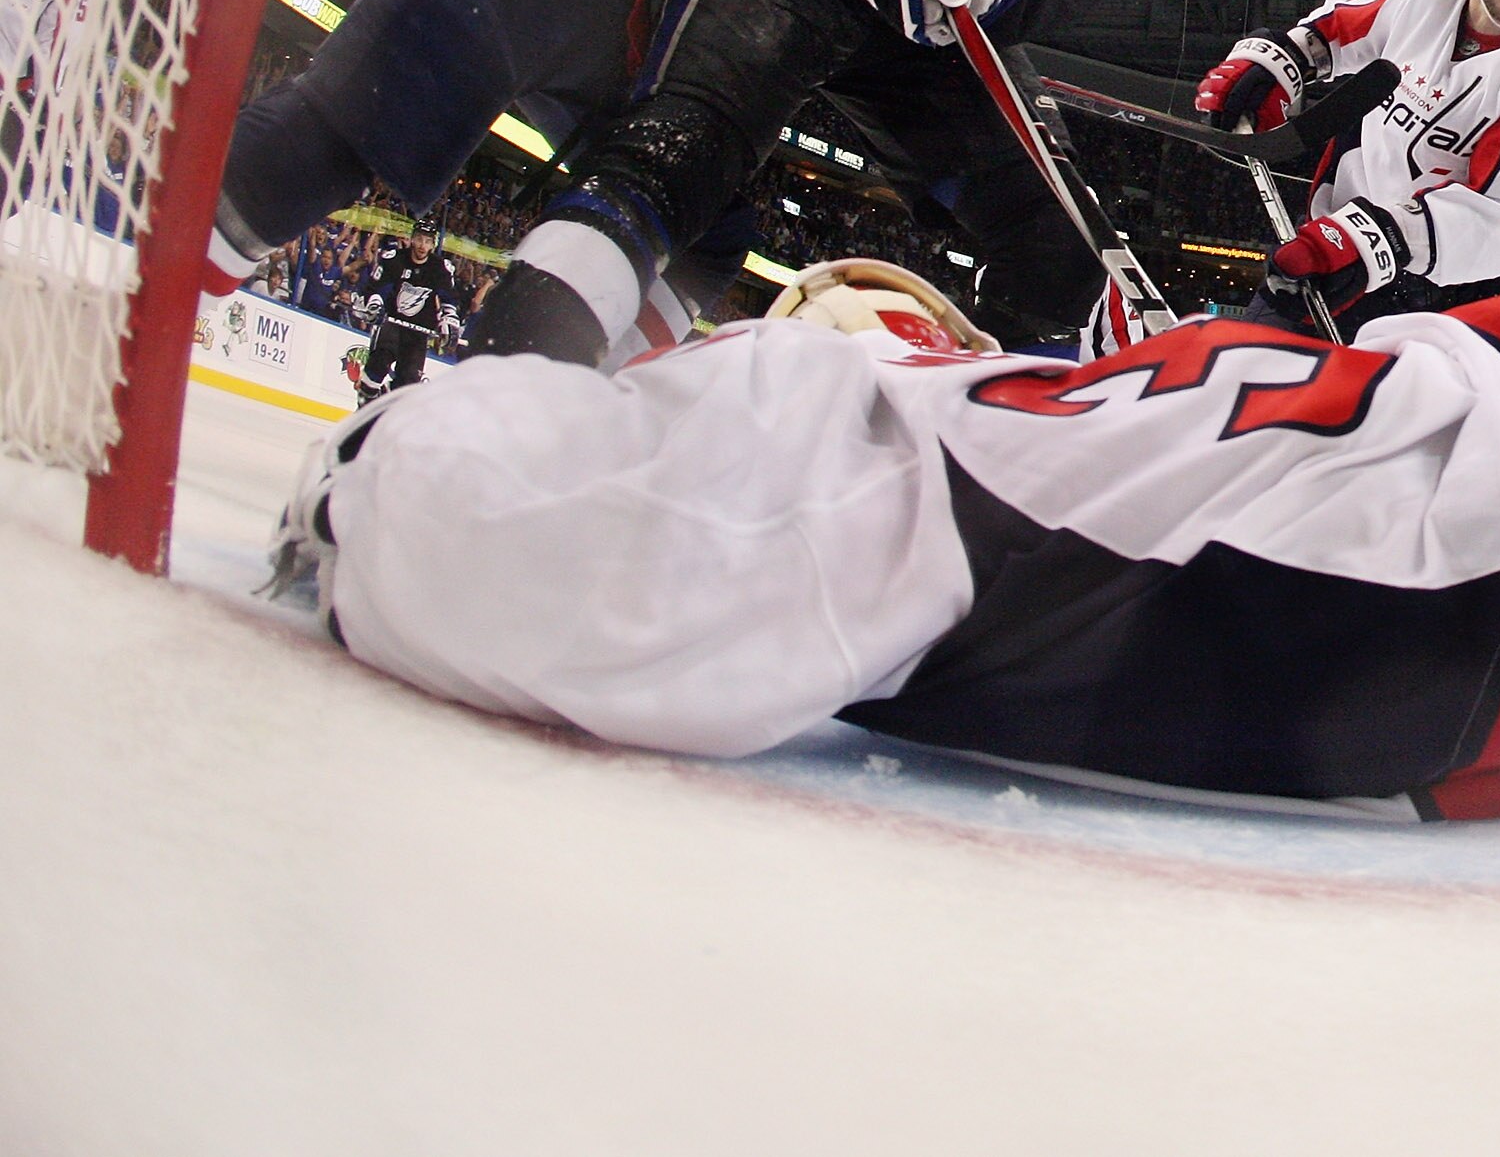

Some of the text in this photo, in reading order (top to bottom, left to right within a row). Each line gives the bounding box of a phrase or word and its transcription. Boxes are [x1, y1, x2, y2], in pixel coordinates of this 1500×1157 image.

[1399, 82, 1434, 112] HINGTON
[257, 315, 290, 343] MAY
[254, 343, 287, 365] 19-22
